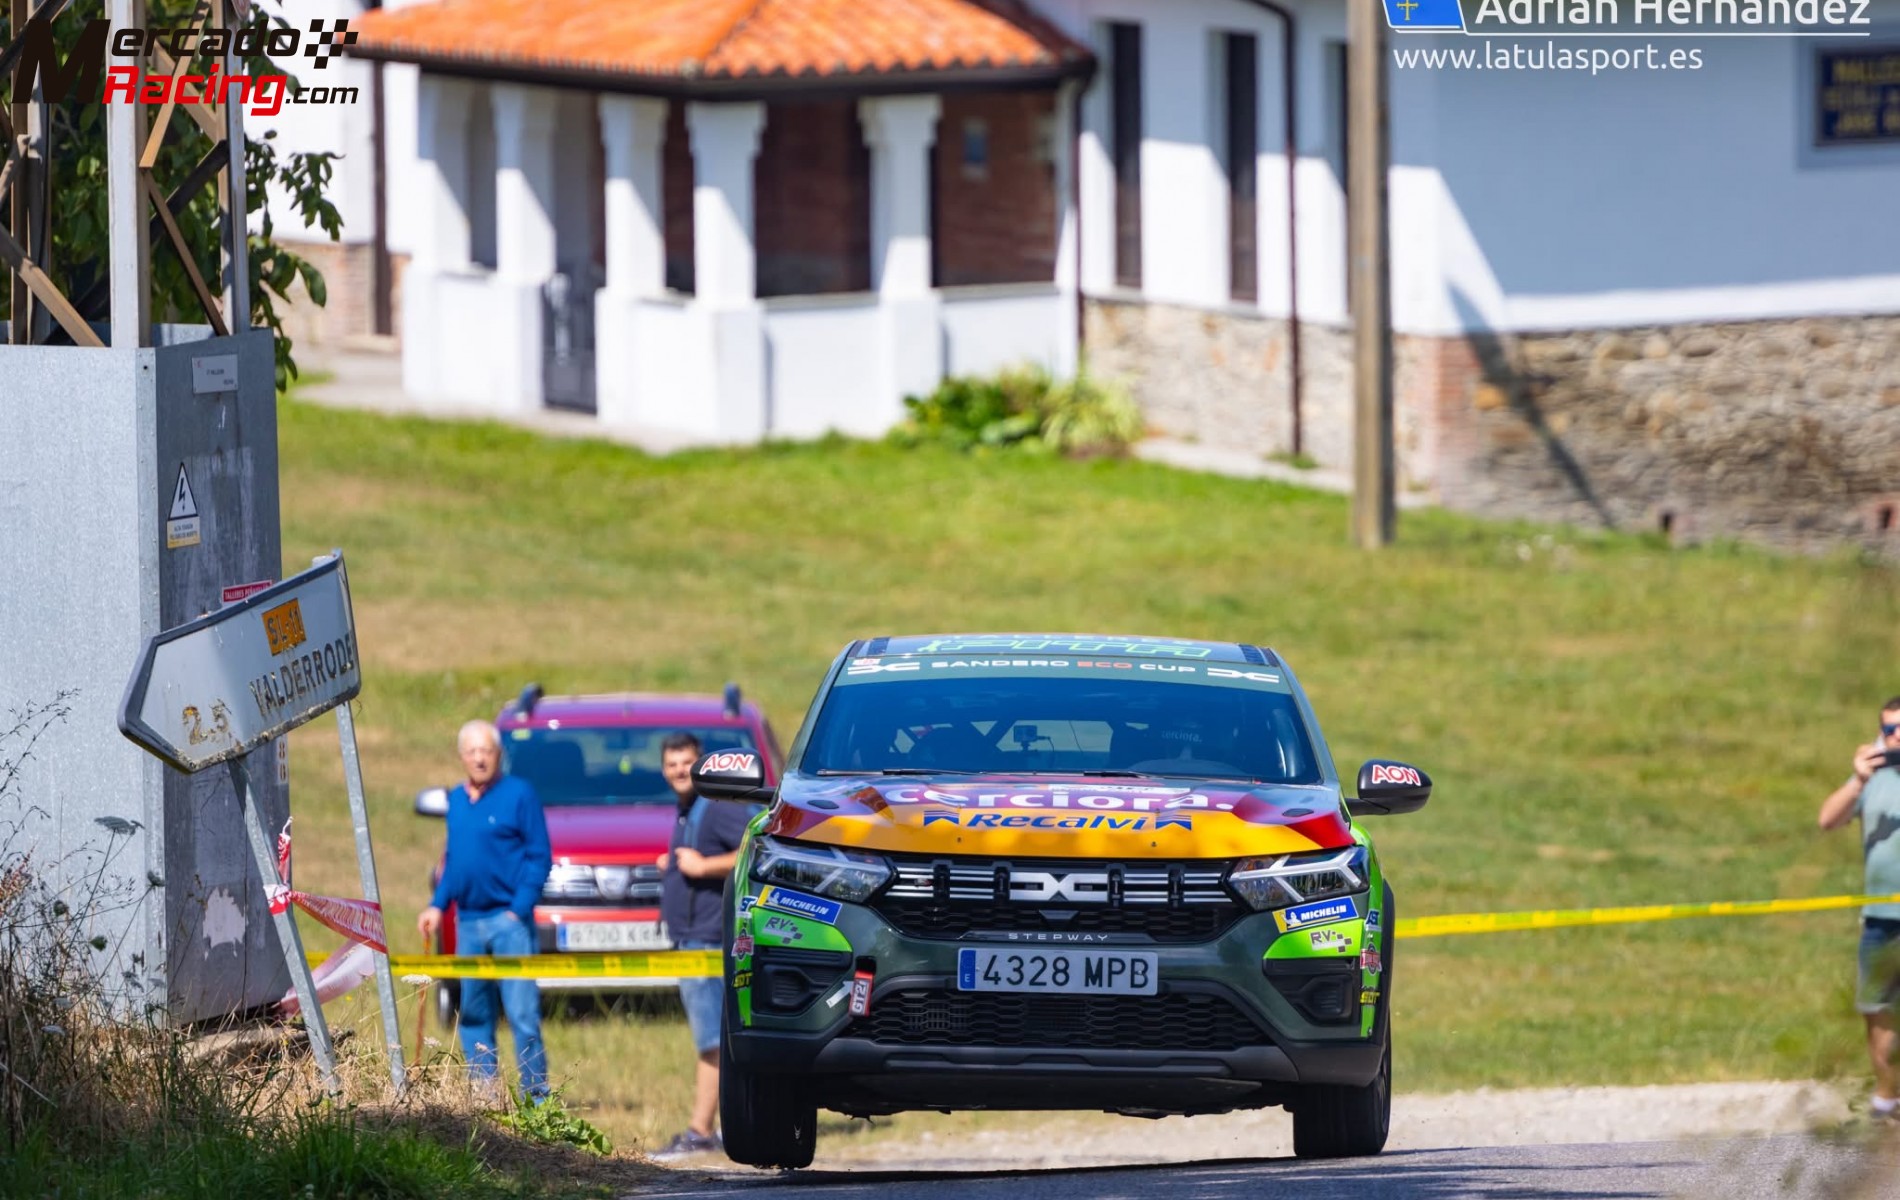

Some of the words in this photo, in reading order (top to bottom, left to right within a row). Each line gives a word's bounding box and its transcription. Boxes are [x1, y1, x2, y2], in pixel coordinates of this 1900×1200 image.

[931, 660, 1069, 668] SANDERO
[1077, 661, 1133, 669] ECO
[1139, 664, 1196, 672] CUP
[700, 753, 754, 774] AON
[1372, 764, 1422, 786] AON
[966, 813, 1148, 831] Recalvi
[780, 896, 829, 916] MICHELIN
[1300, 904, 1347, 921] MICHELIN
[1008, 932, 1109, 941] STEPWAY
[982, 955, 1070, 987] 4328
[1084, 956, 1149, 989] MPB
